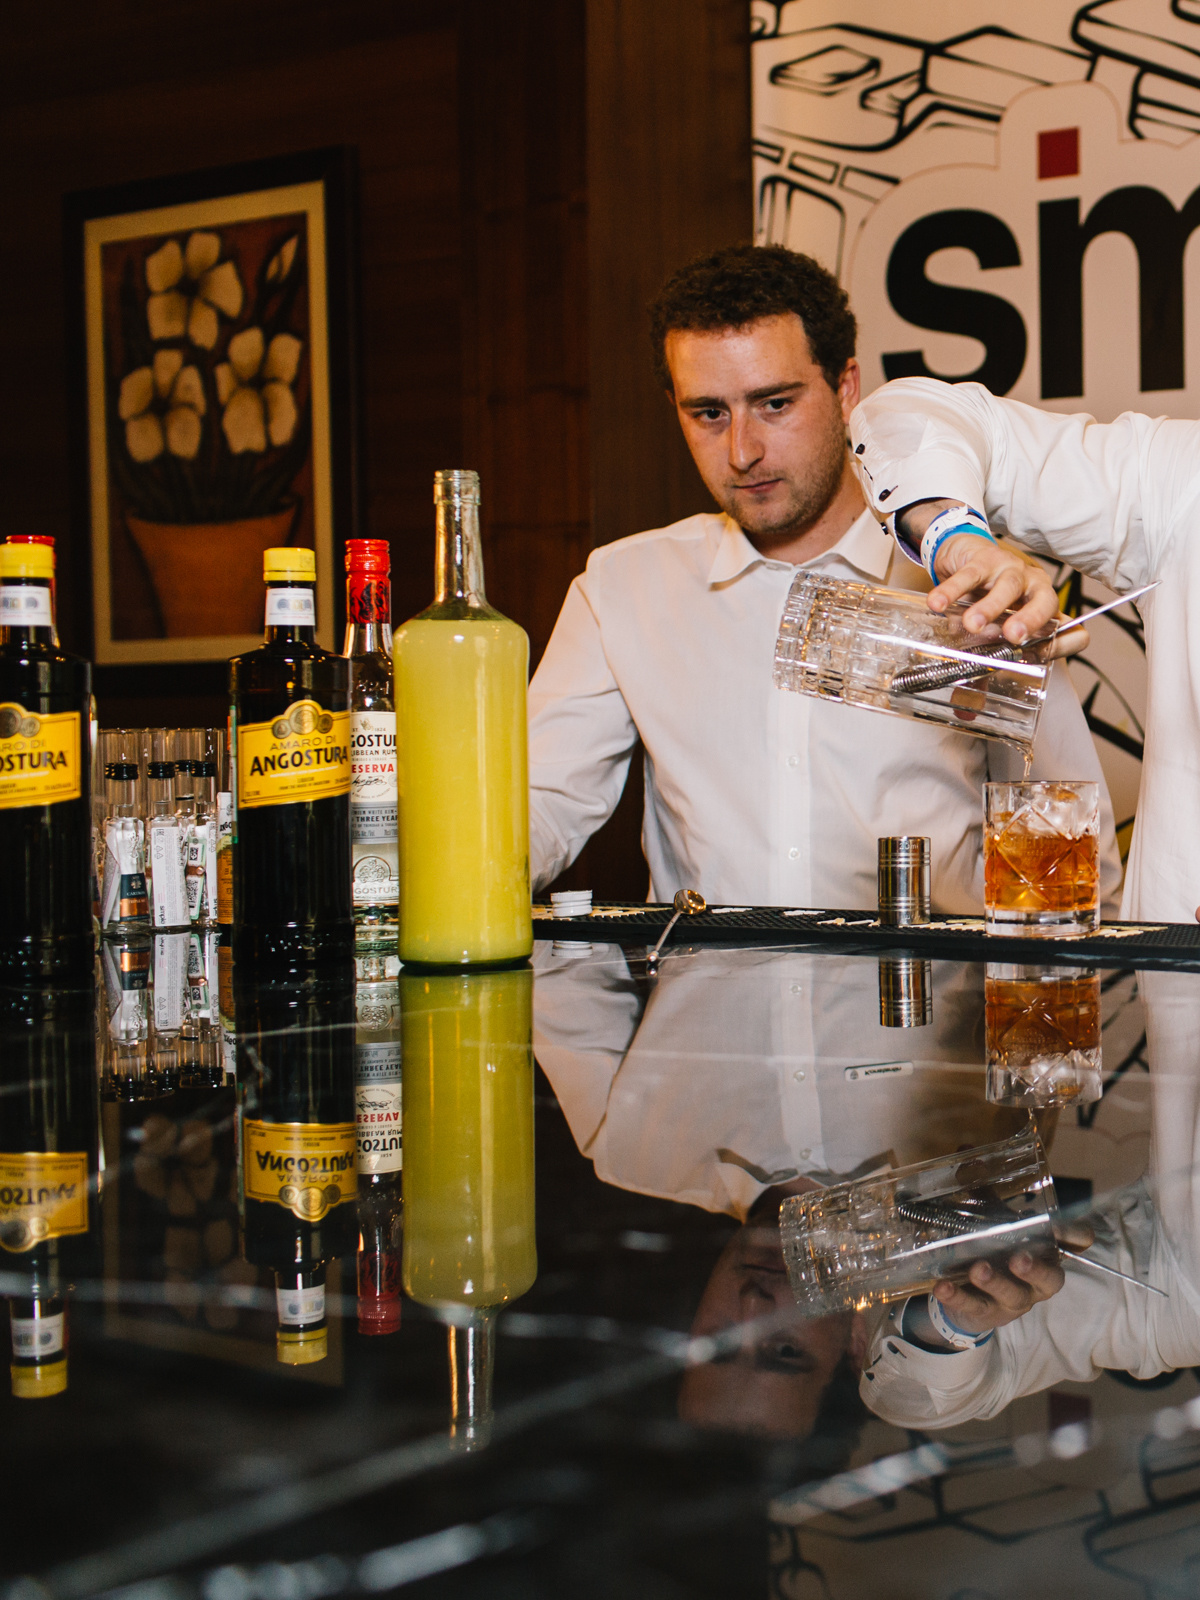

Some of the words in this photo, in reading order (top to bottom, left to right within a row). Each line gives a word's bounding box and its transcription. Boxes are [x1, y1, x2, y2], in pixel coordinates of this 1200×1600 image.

[270, 737, 322, 751] AMARO
[325, 735, 336, 745] DI
[382, 748, 398, 756] RUM
[250, 746, 348, 776] ANGOSTURA
